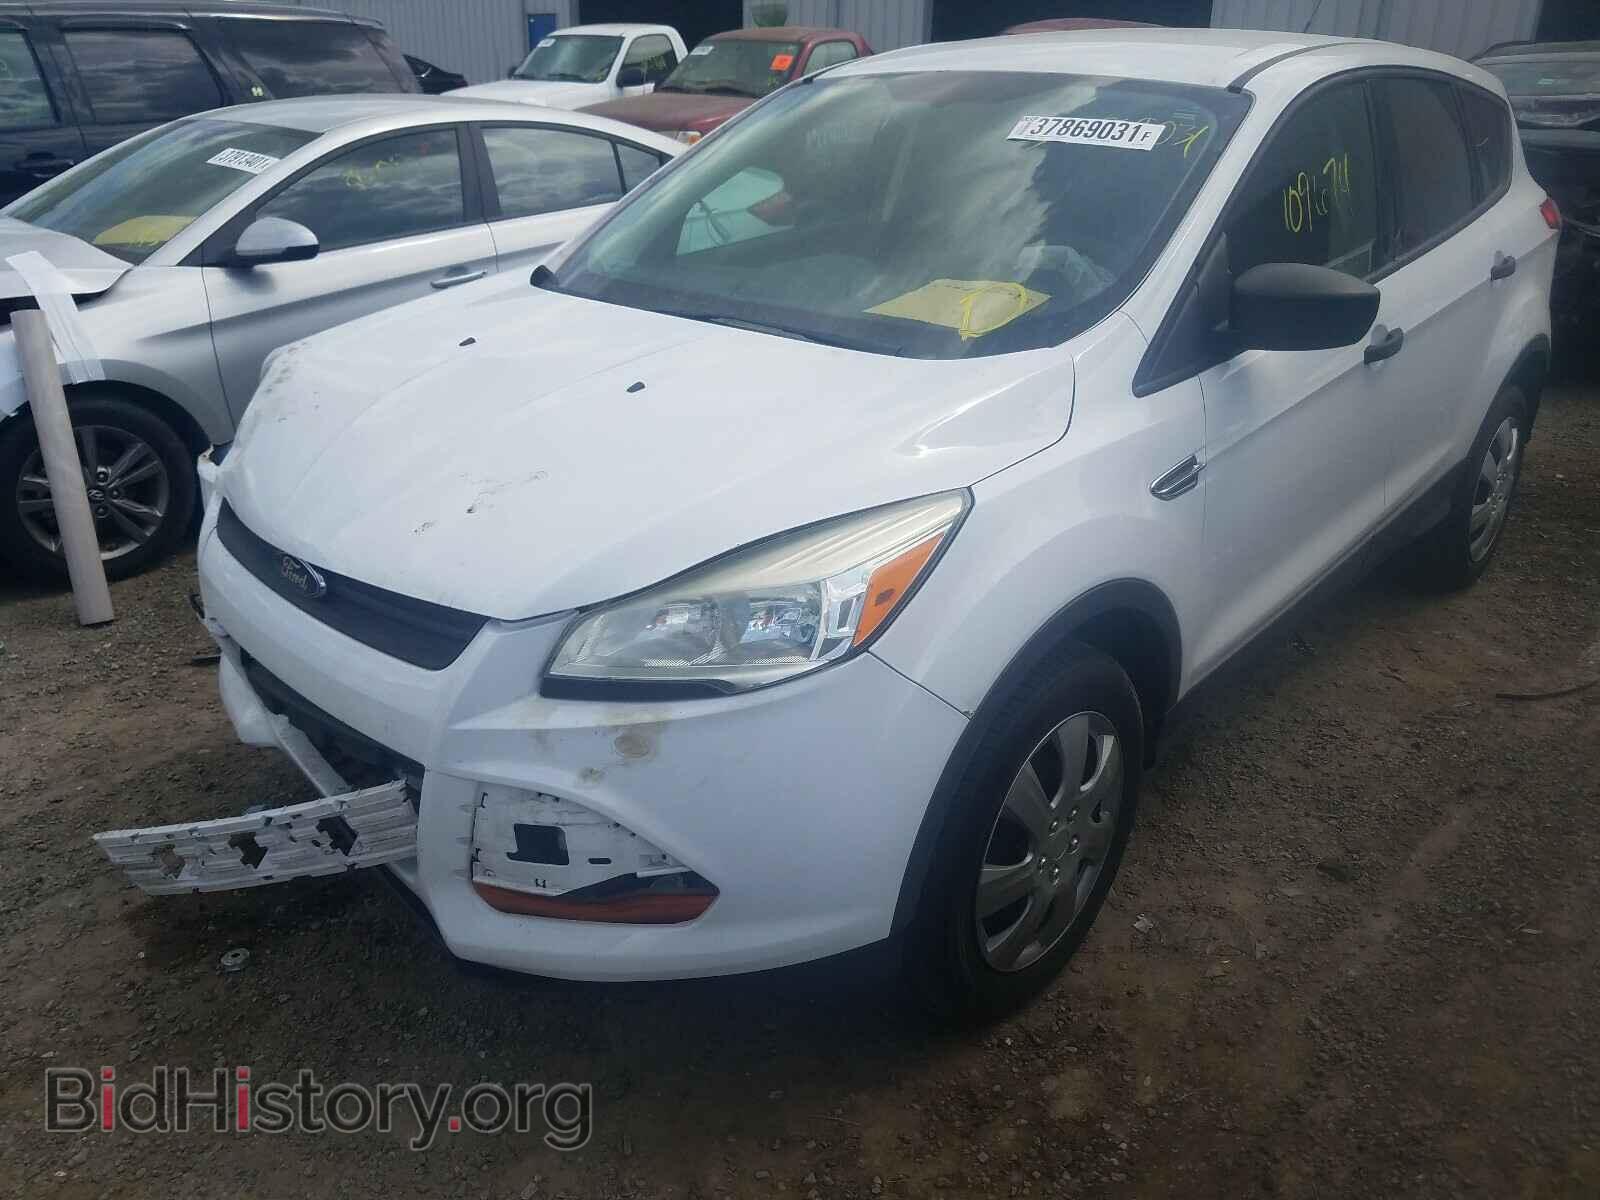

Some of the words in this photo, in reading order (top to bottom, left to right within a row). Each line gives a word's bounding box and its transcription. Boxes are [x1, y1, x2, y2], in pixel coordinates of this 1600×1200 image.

[1030, 117, 1143, 143] 37869031
[1140, 131, 1152, 142] F
[282, 556, 308, 590] Ford
